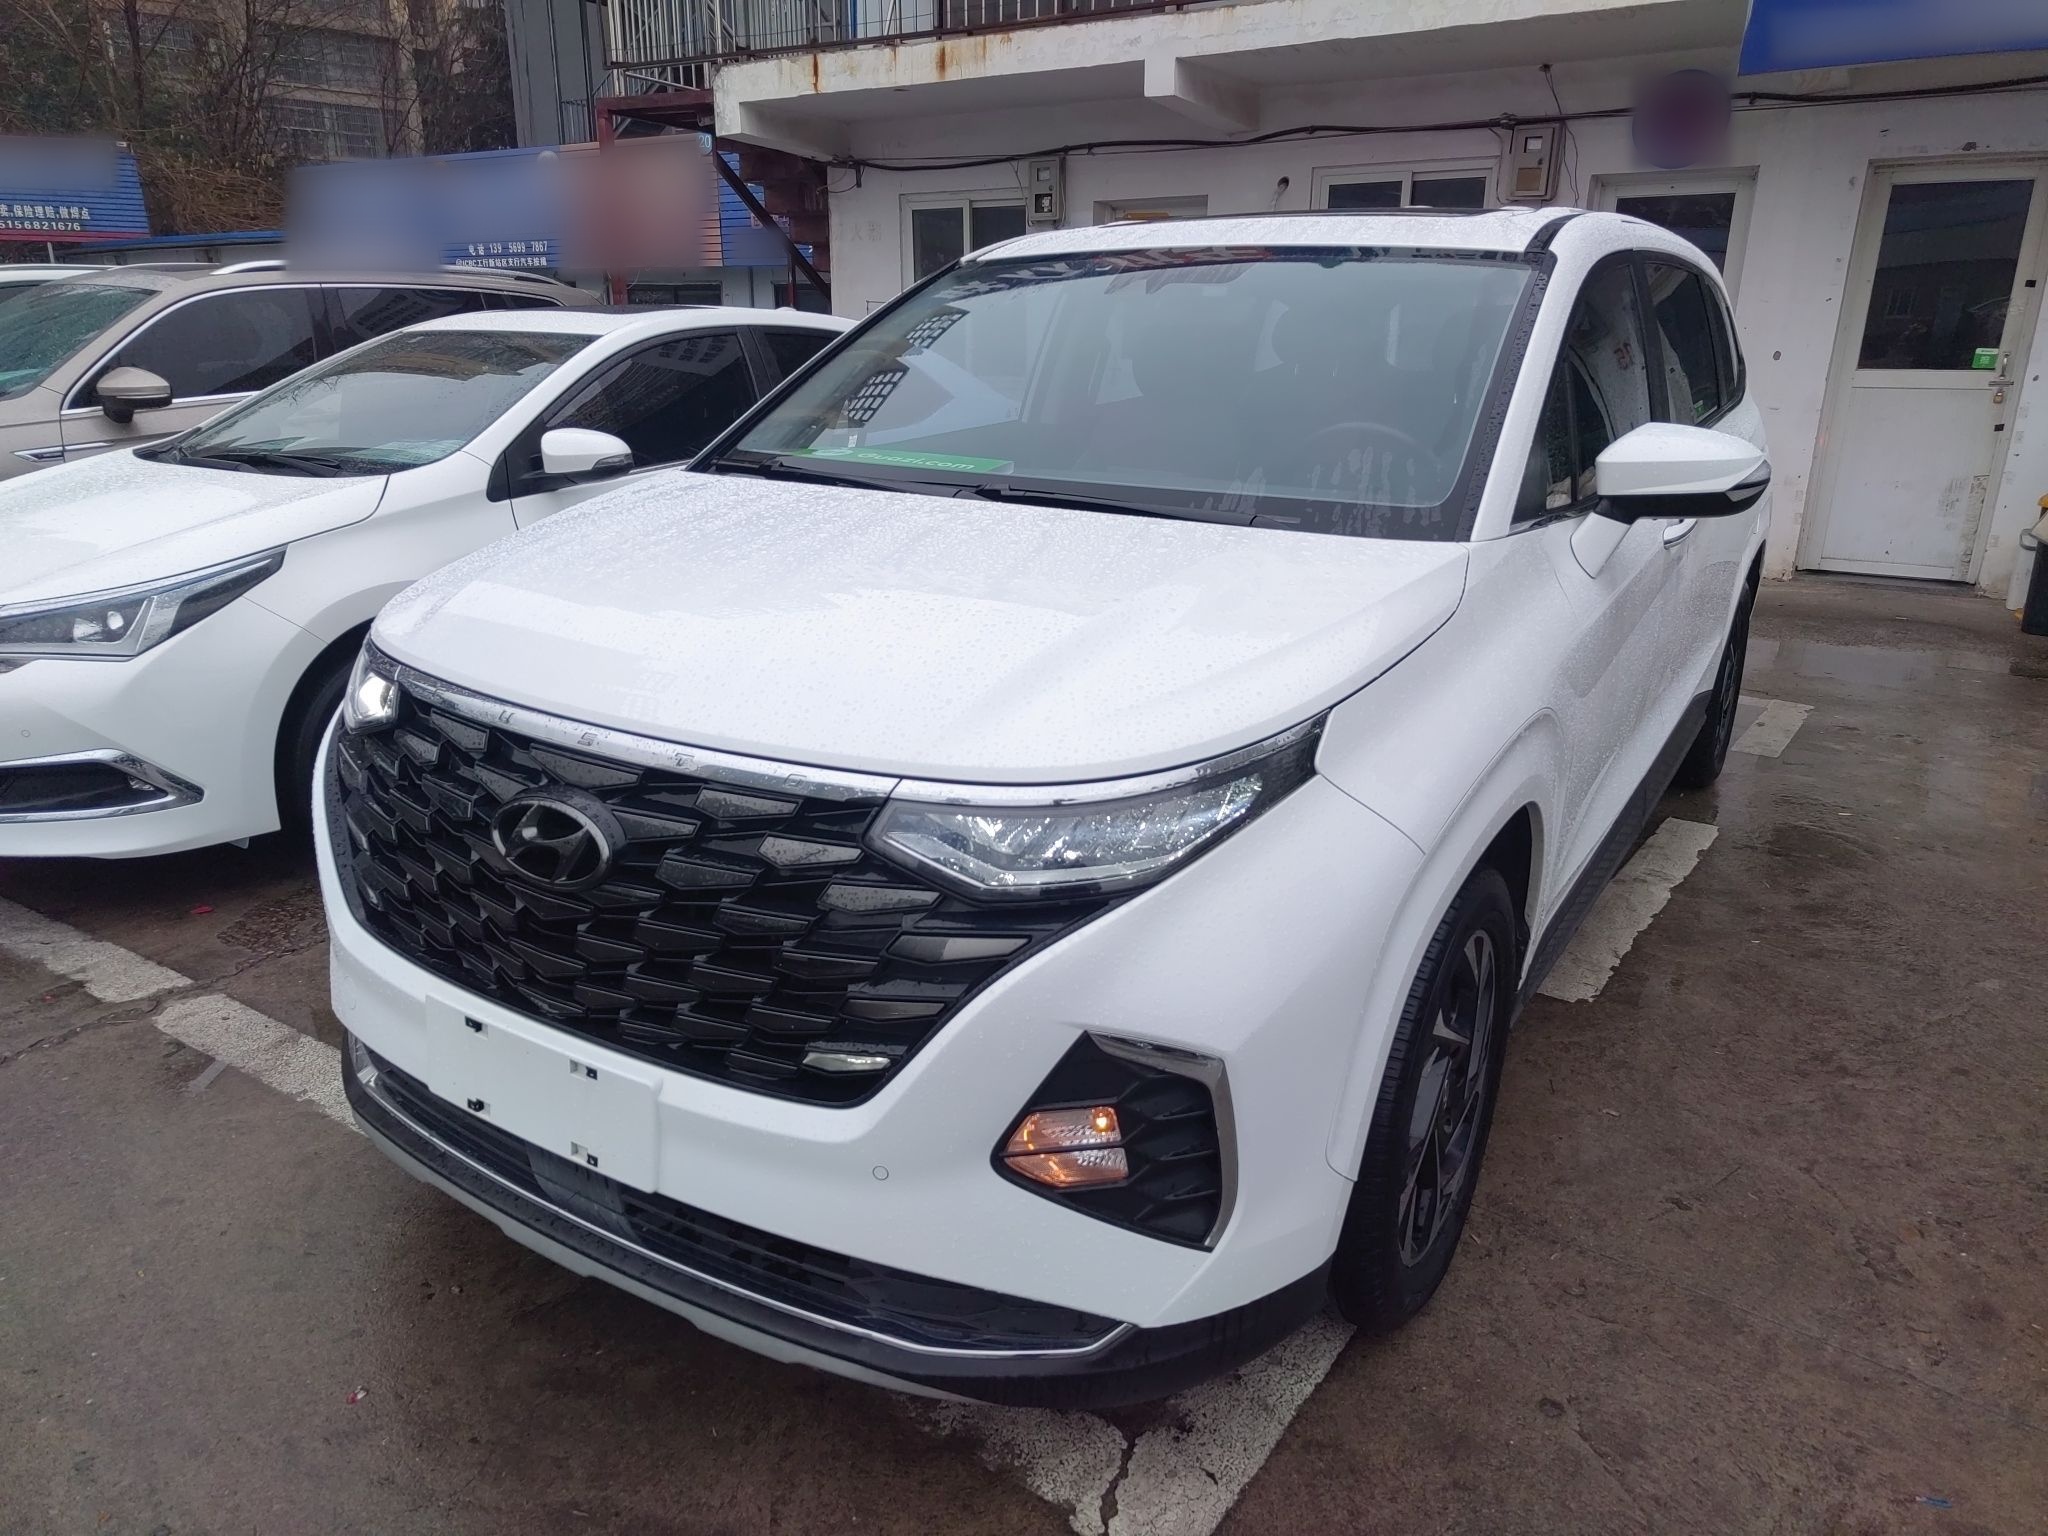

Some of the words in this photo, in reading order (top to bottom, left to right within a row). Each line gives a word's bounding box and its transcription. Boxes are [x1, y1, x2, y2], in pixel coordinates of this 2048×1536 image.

[698, 135, 711, 148] 20
[489, 242, 502, 254] 139
[531, 241, 548, 252] 7867
